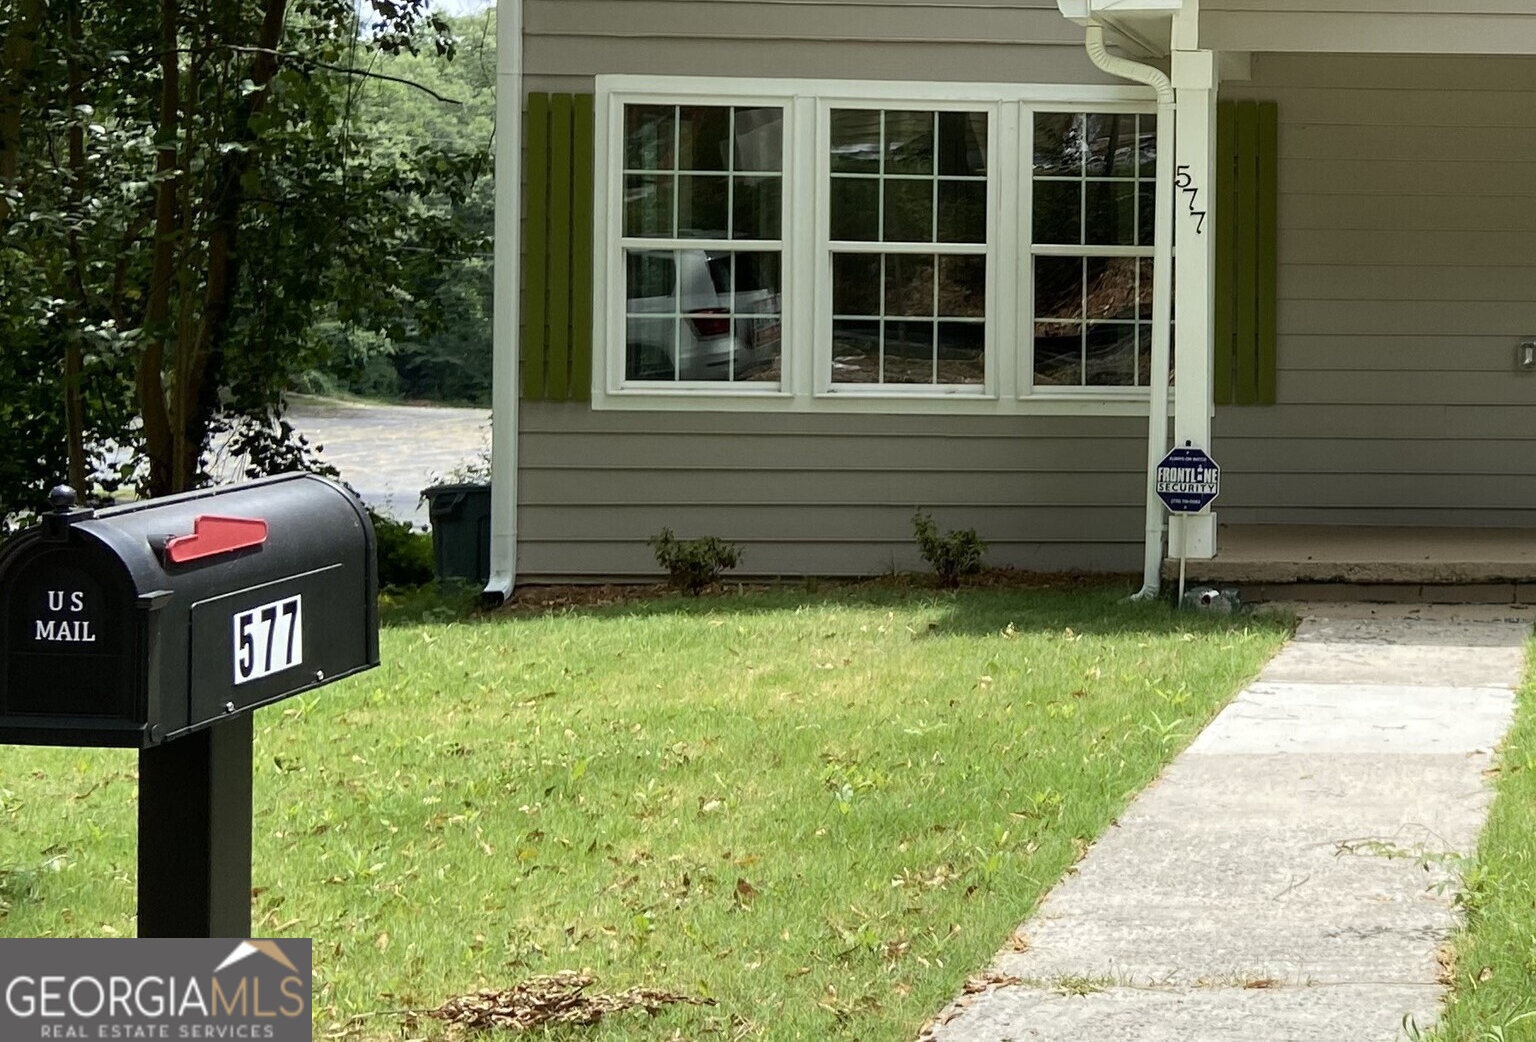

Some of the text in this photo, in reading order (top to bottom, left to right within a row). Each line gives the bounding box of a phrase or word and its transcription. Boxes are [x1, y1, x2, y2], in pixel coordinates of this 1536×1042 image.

[1174, 164, 1206, 234] 577
[1158, 464, 1218, 483] FRONTLINE
[1158, 483, 1215, 492] SECURITY
[35, 619, 96, 642] MAIL
[239, 599, 298, 678] 577
